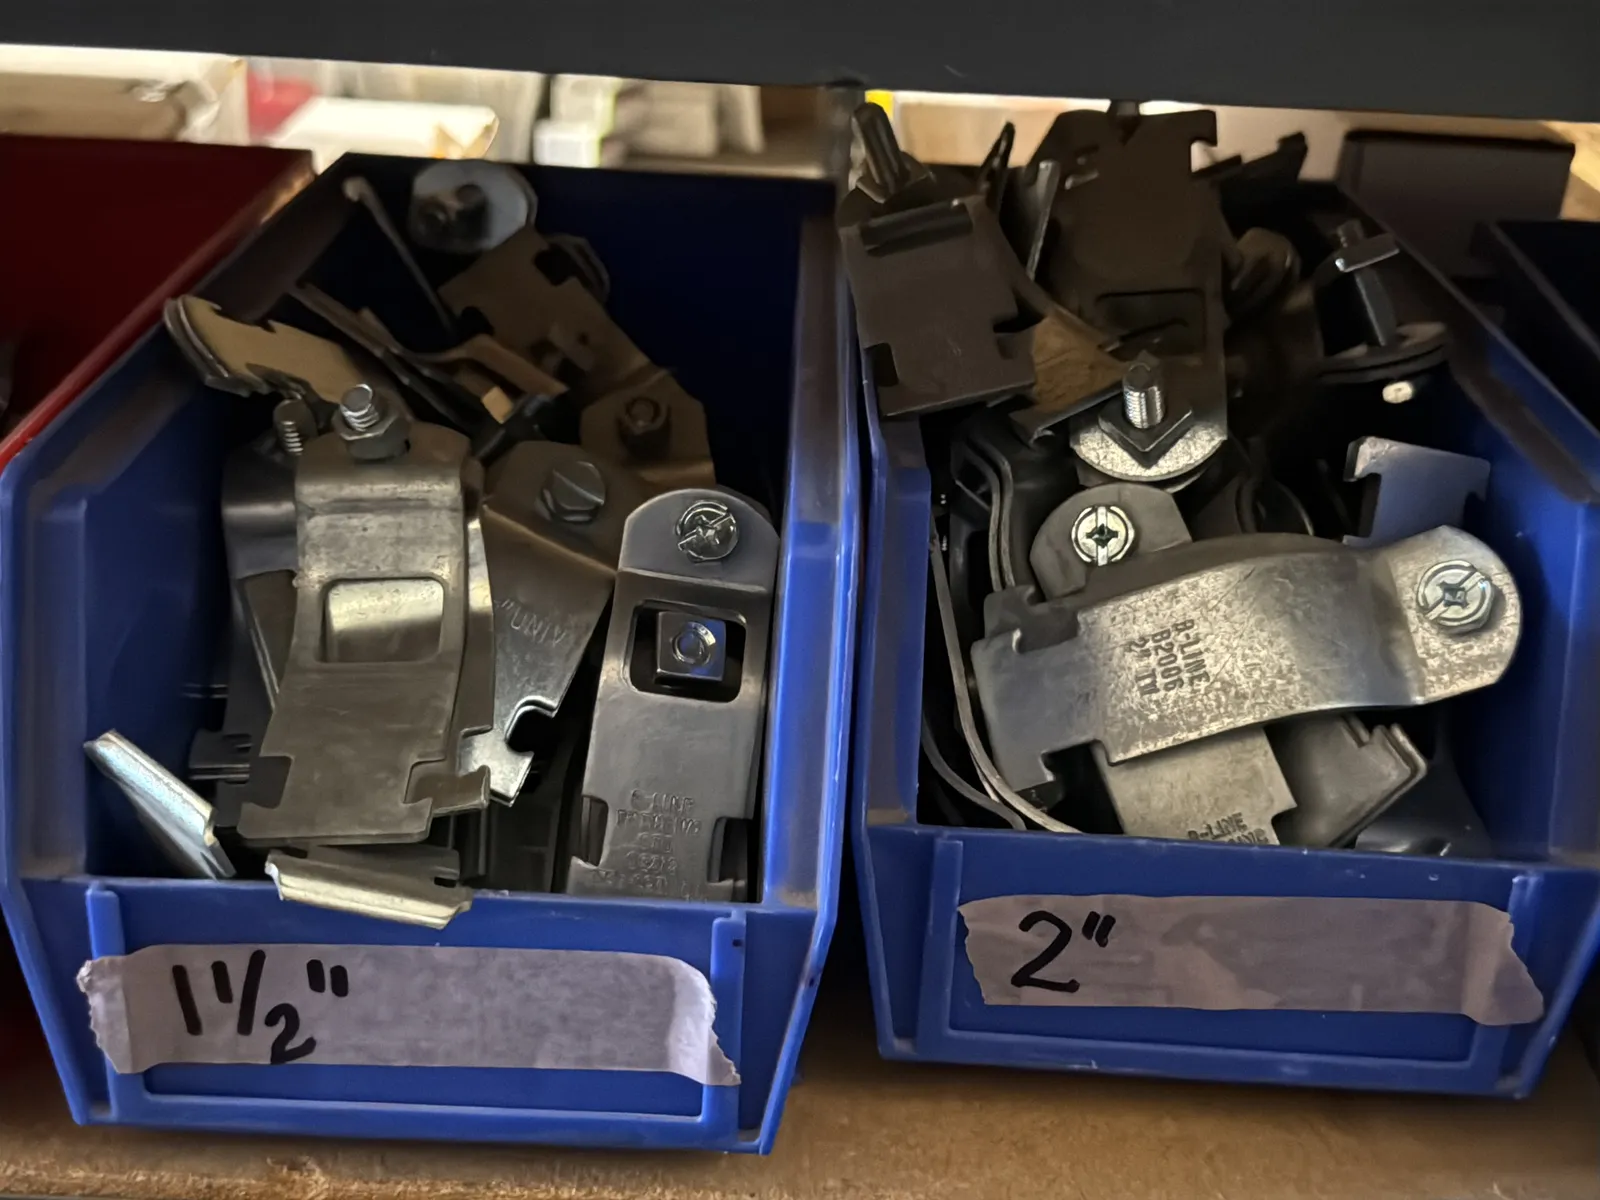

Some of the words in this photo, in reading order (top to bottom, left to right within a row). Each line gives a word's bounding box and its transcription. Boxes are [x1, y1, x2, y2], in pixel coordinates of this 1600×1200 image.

[1151, 628, 1184, 692] B2006
[1172, 618, 1210, 688] B-LINE
[1010, 909, 1117, 994] 2"
